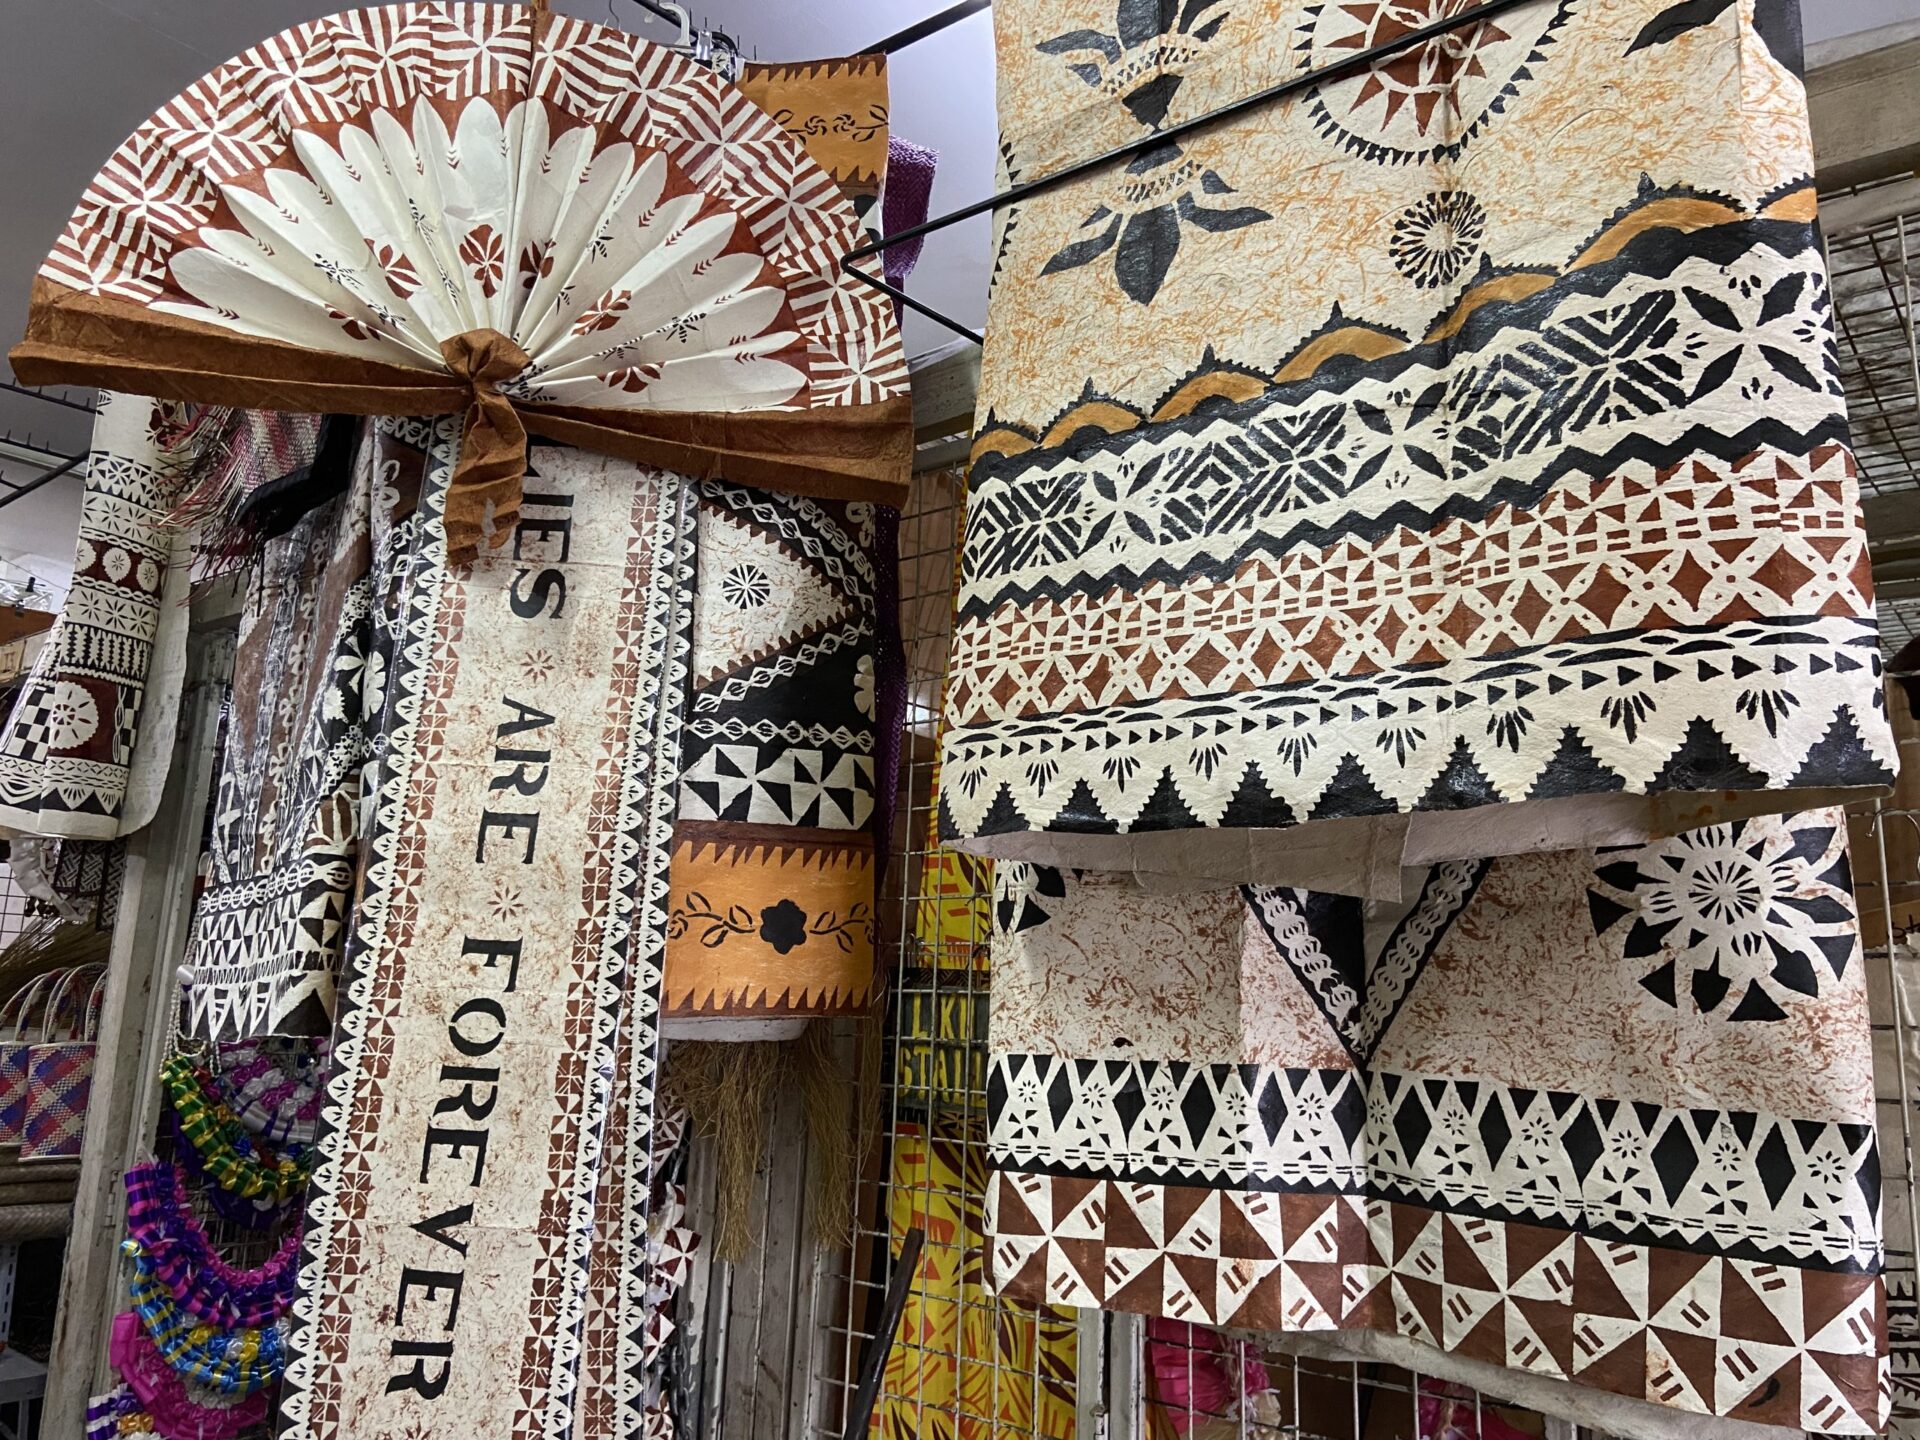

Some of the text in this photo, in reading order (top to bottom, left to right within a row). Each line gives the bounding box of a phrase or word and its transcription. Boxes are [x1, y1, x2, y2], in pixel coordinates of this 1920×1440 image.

[384, 434, 579, 1400] LIES ARE FOREVER
